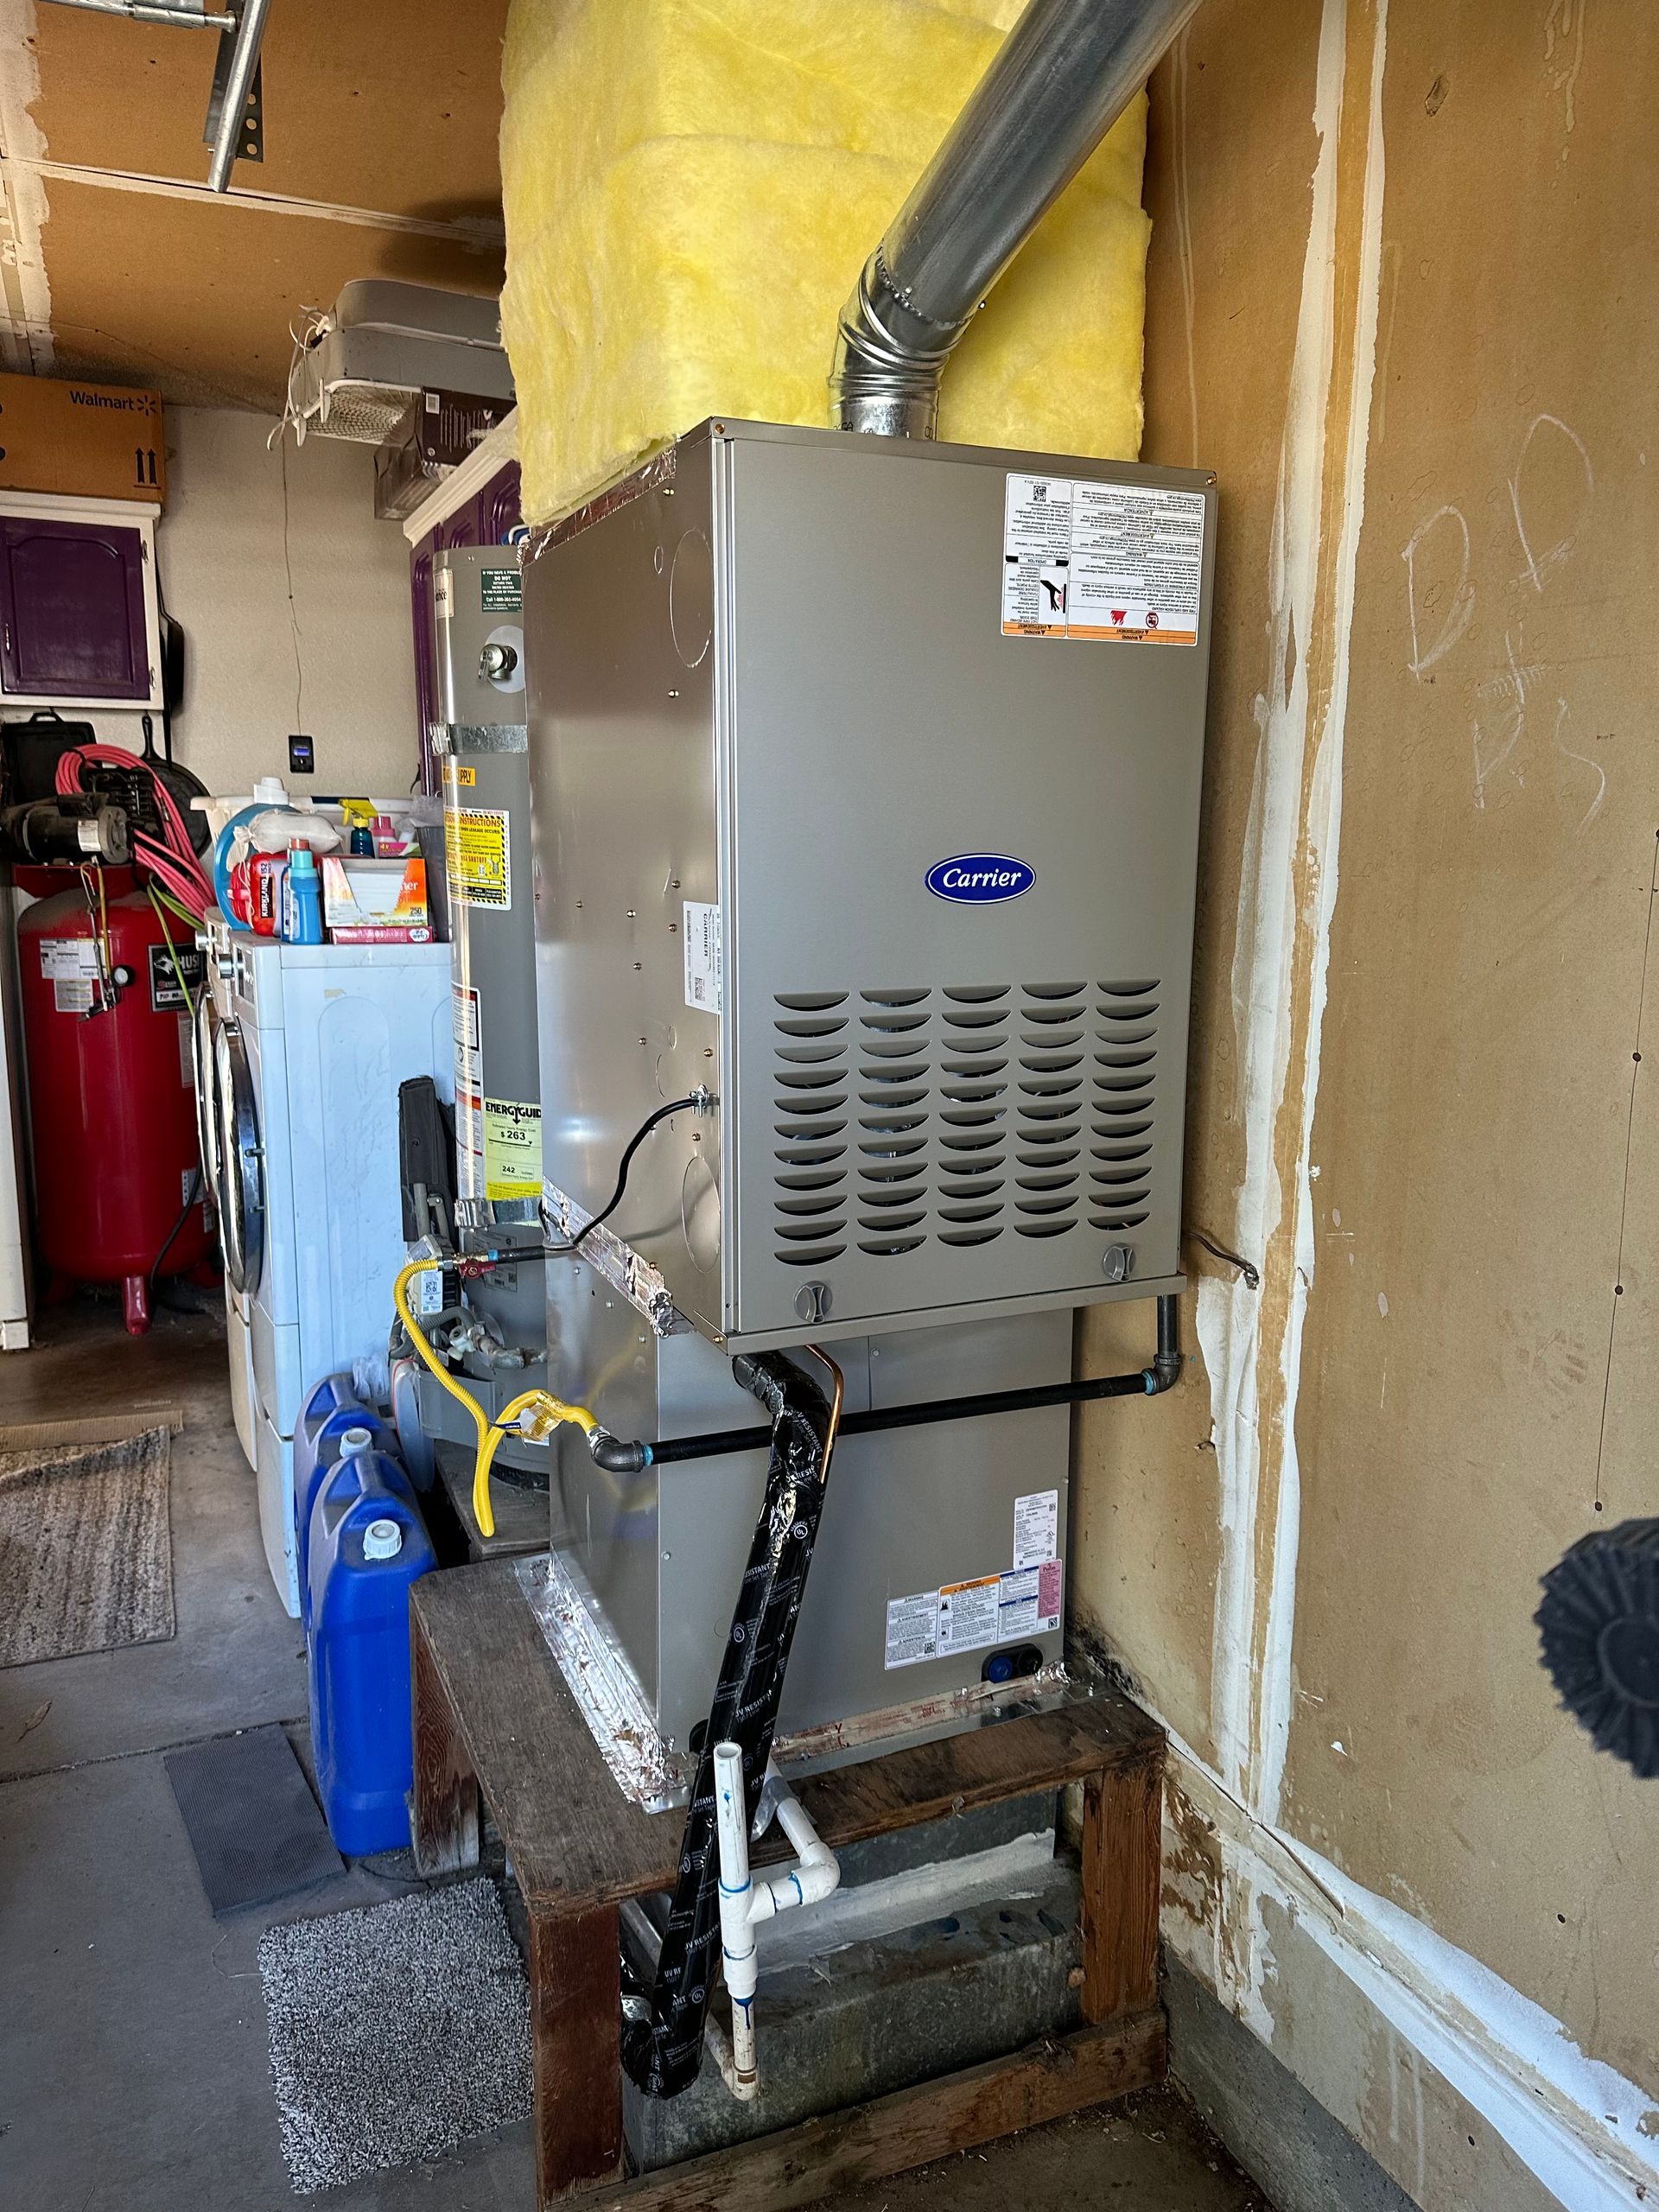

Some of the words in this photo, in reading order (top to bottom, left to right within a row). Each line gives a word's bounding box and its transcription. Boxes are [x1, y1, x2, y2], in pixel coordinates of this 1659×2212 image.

[70, 391, 134, 410] Walmart
[943, 868, 1021, 888] Carrier
[486, 1102, 542, 1118] ENERGYGUID
[507, 1130, 525, 1141] 263
[745, 1563, 770, 1578] ESISTANT
[790, 1604, 800, 1613] AN
